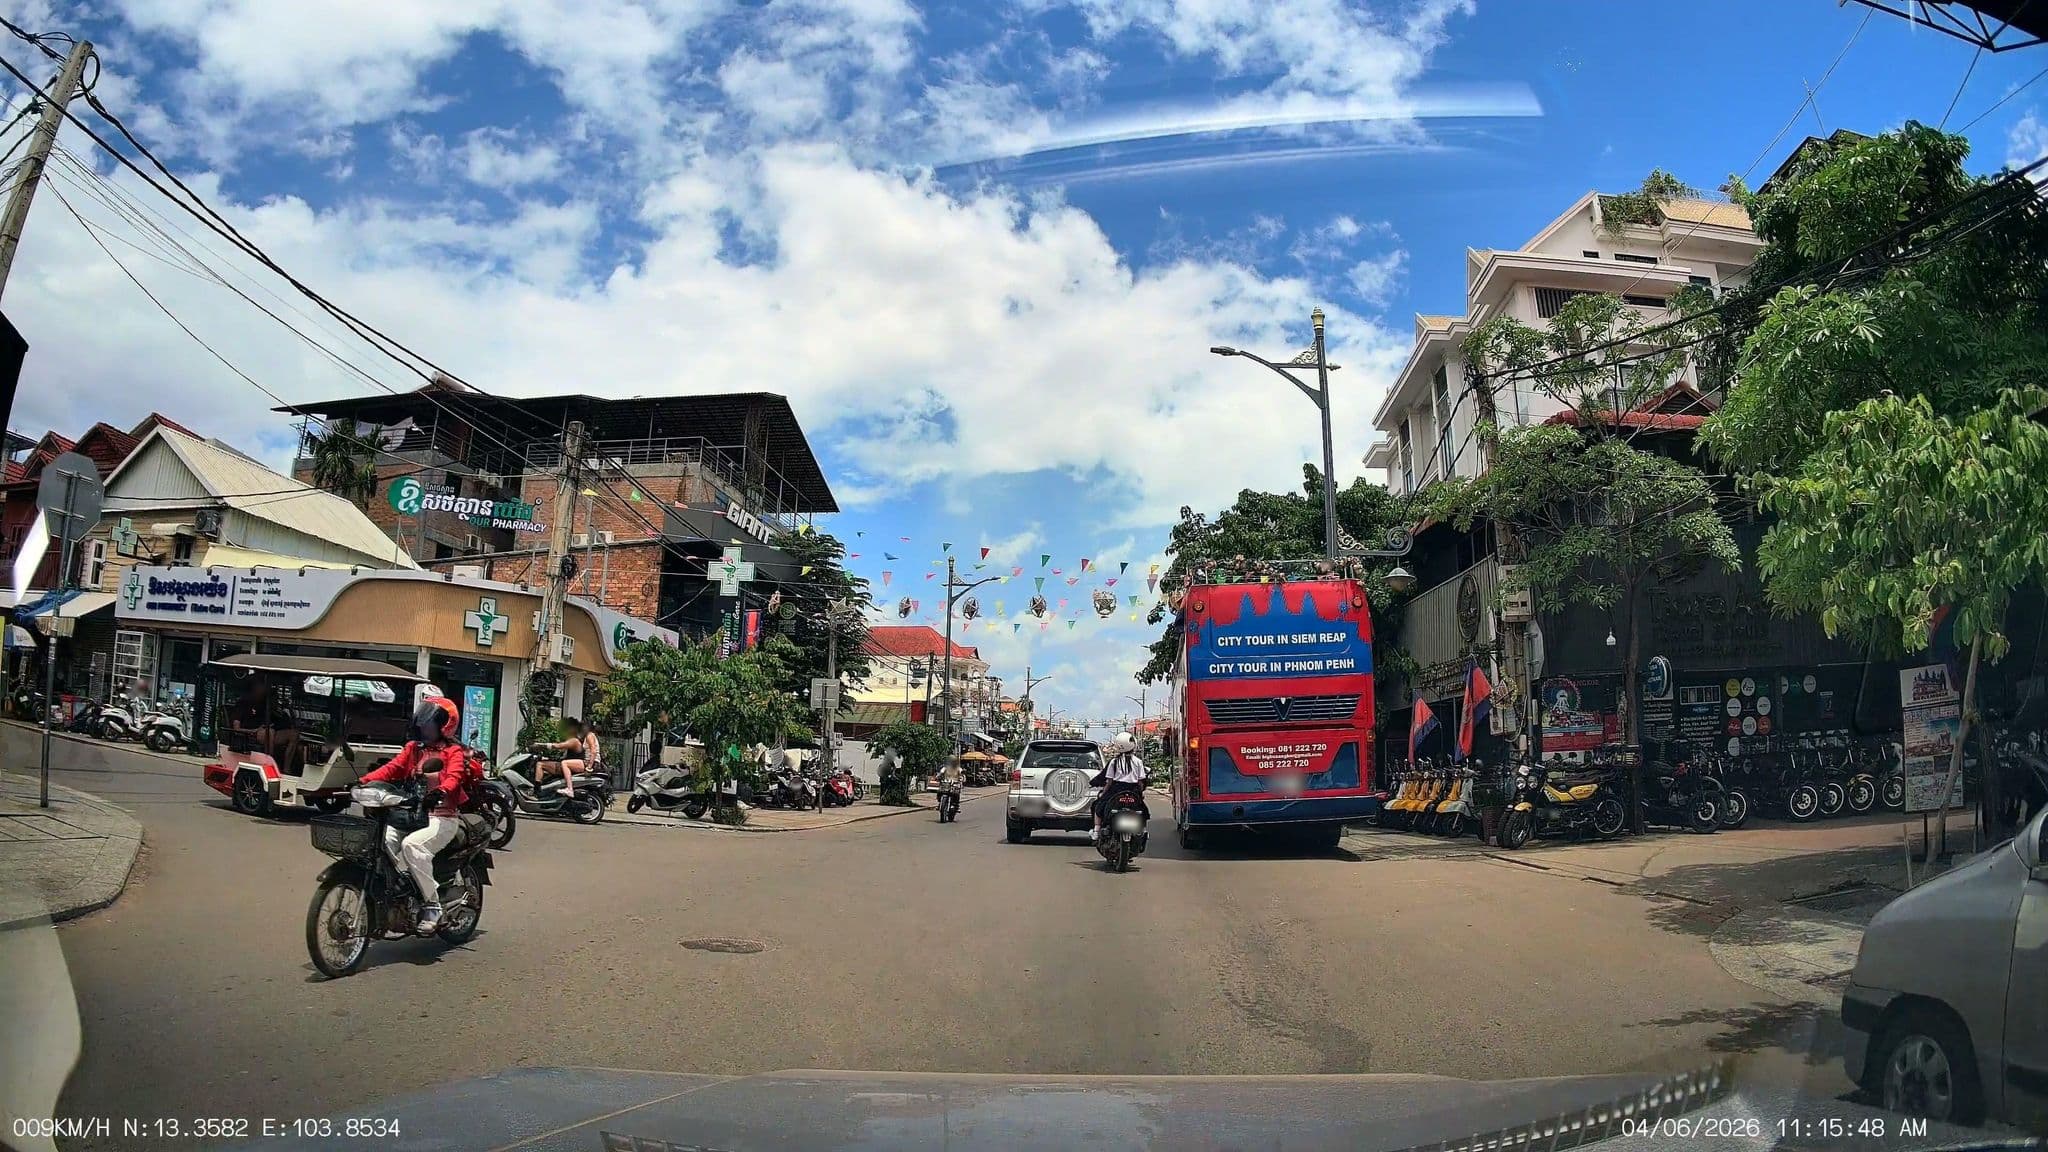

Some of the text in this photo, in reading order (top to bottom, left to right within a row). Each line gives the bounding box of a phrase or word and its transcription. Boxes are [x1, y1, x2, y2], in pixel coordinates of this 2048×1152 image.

[469, 515, 547, 533] OUR PHARMACY
[726, 501, 774, 544] GIANT
[1217, 632, 1346, 647] CITY TOUR IN SIEM REAP
[1209, 659, 1355, 674] CITY TOUR IN PHNOM PENH
[1240, 743, 1327, 755] Booking: 081 222 720
[1258, 759, 1309, 769] 085 222 720
